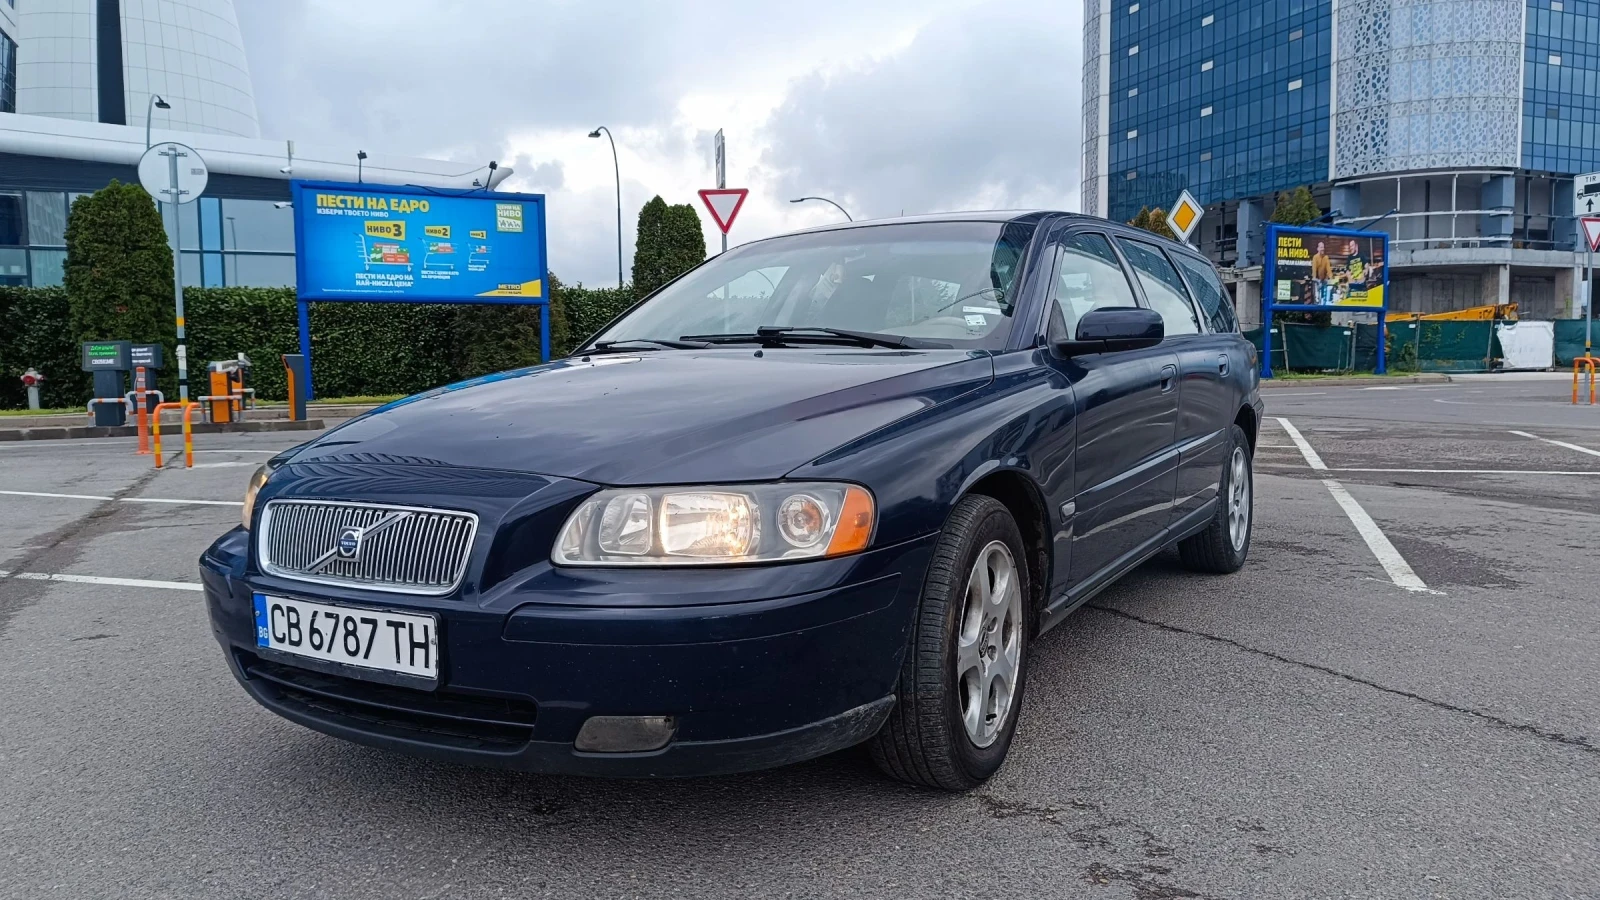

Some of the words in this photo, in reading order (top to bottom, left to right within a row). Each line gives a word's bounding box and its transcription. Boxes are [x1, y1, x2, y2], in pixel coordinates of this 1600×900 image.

[316, 194, 364, 208] ПЕСТИ
[366, 197, 388, 210] НА
[390, 198, 430, 214] ЕДРО
[366, 225, 392, 234] НИВО
[392, 224, 402, 236] 3
[442, 228, 448, 236] 2
[1278, 237, 1302, 248] ПЕСТИ
[1278, 248, 1288, 258] НА
[1288, 248, 1310, 258] НИВО.
[258, 626, 269, 638] BG
[270, 604, 302, 647] CB
[309, 610, 378, 659] 6787
[386, 620, 430, 668] TH
